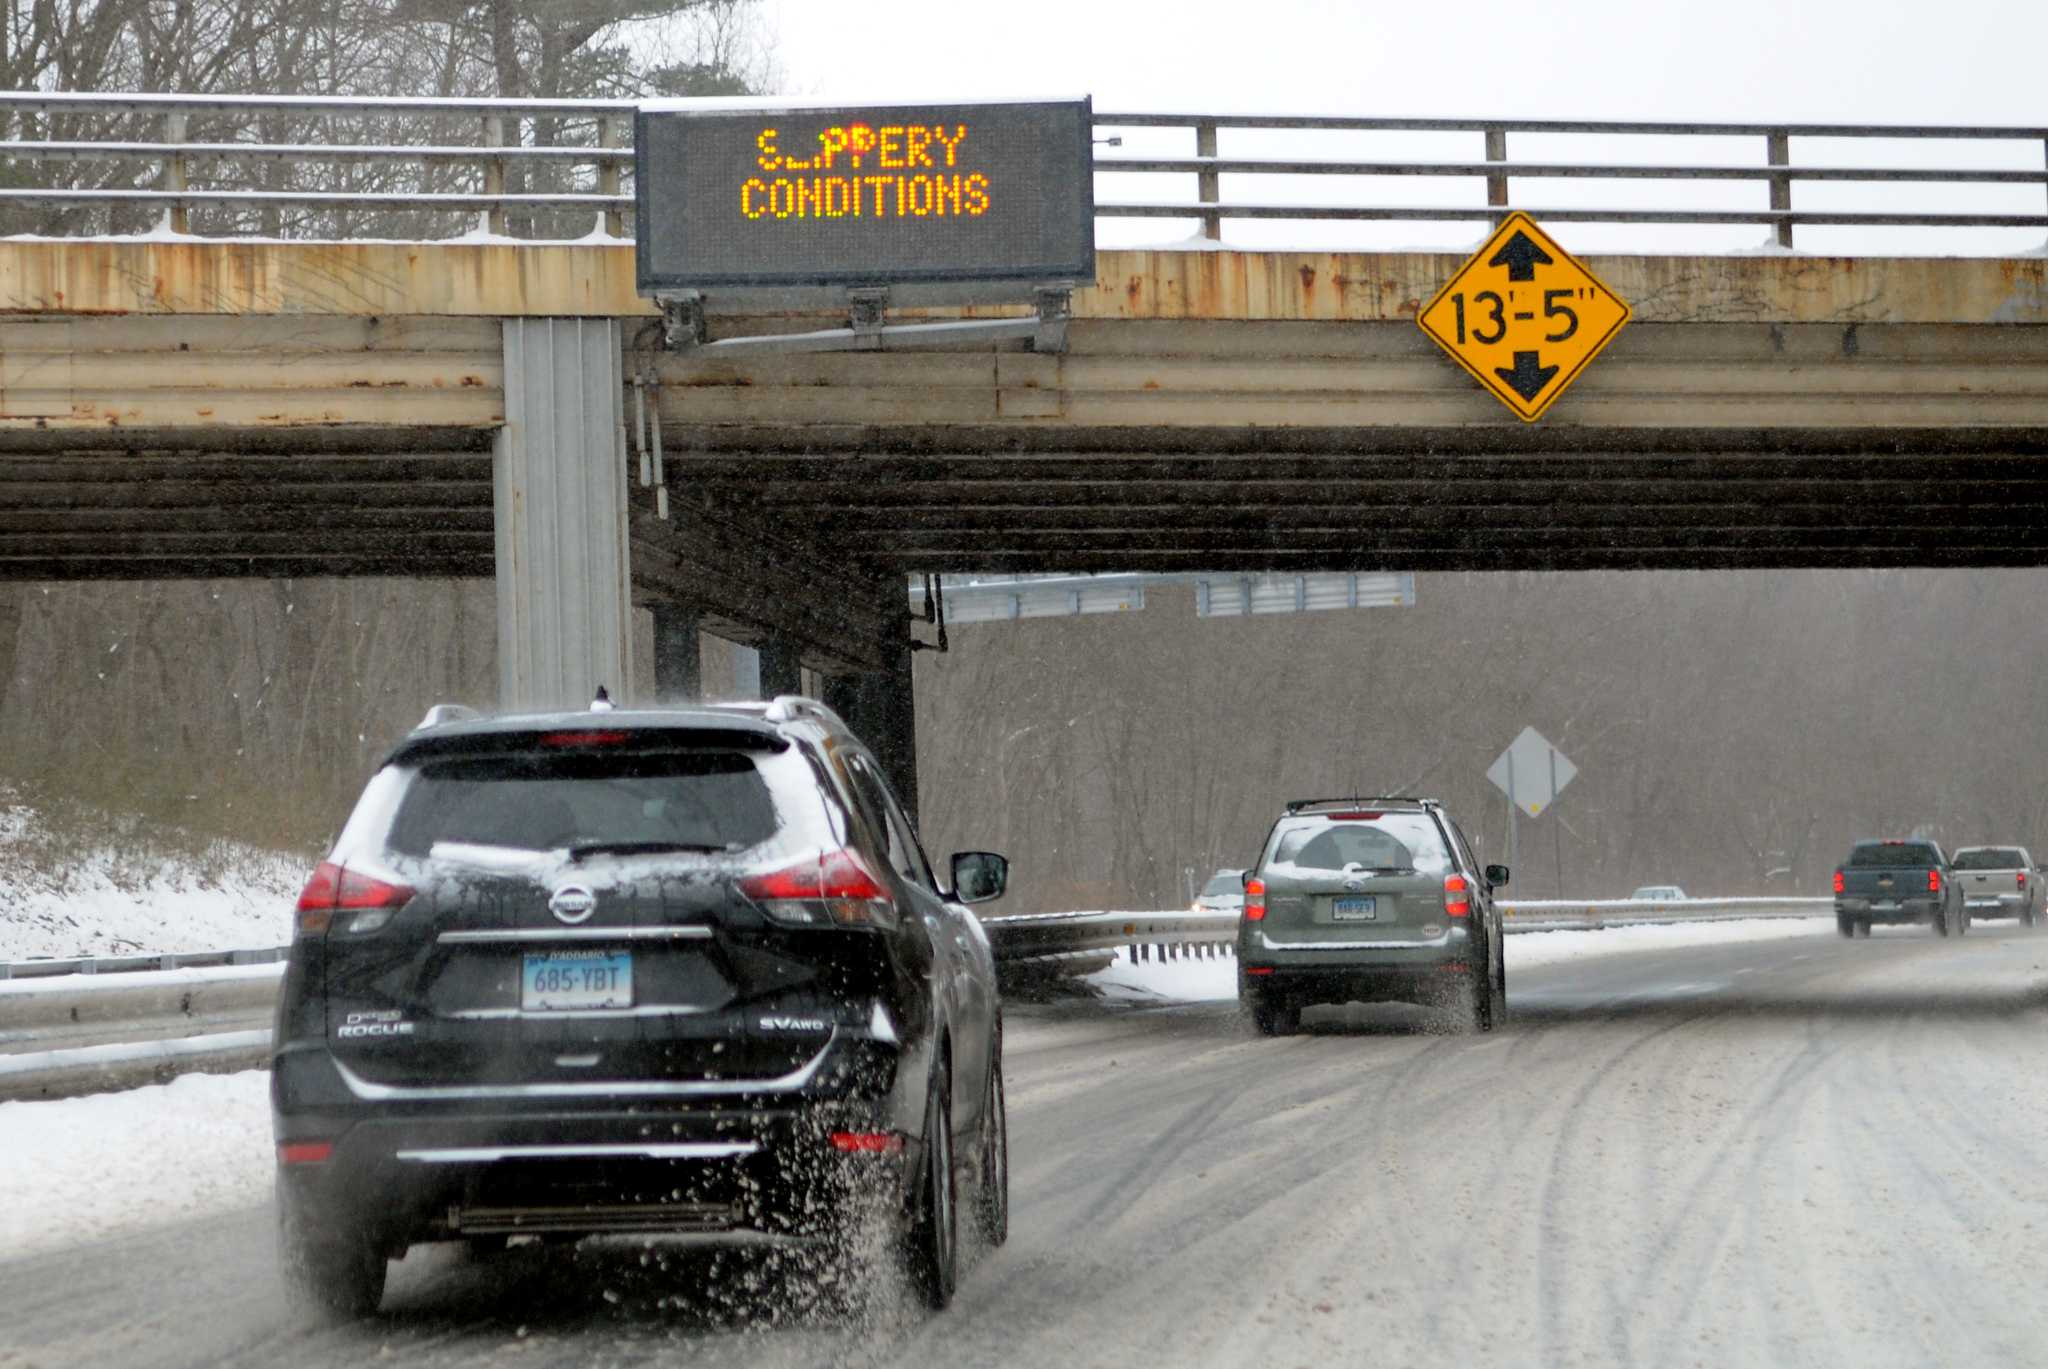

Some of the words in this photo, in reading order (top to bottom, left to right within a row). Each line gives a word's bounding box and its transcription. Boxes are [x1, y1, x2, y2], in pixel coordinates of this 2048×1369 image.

[757, 124, 967, 171] SPPERY
[741, 173, 989, 219] CONDITIONS
[337, 1021, 414, 1038] ROGUE
